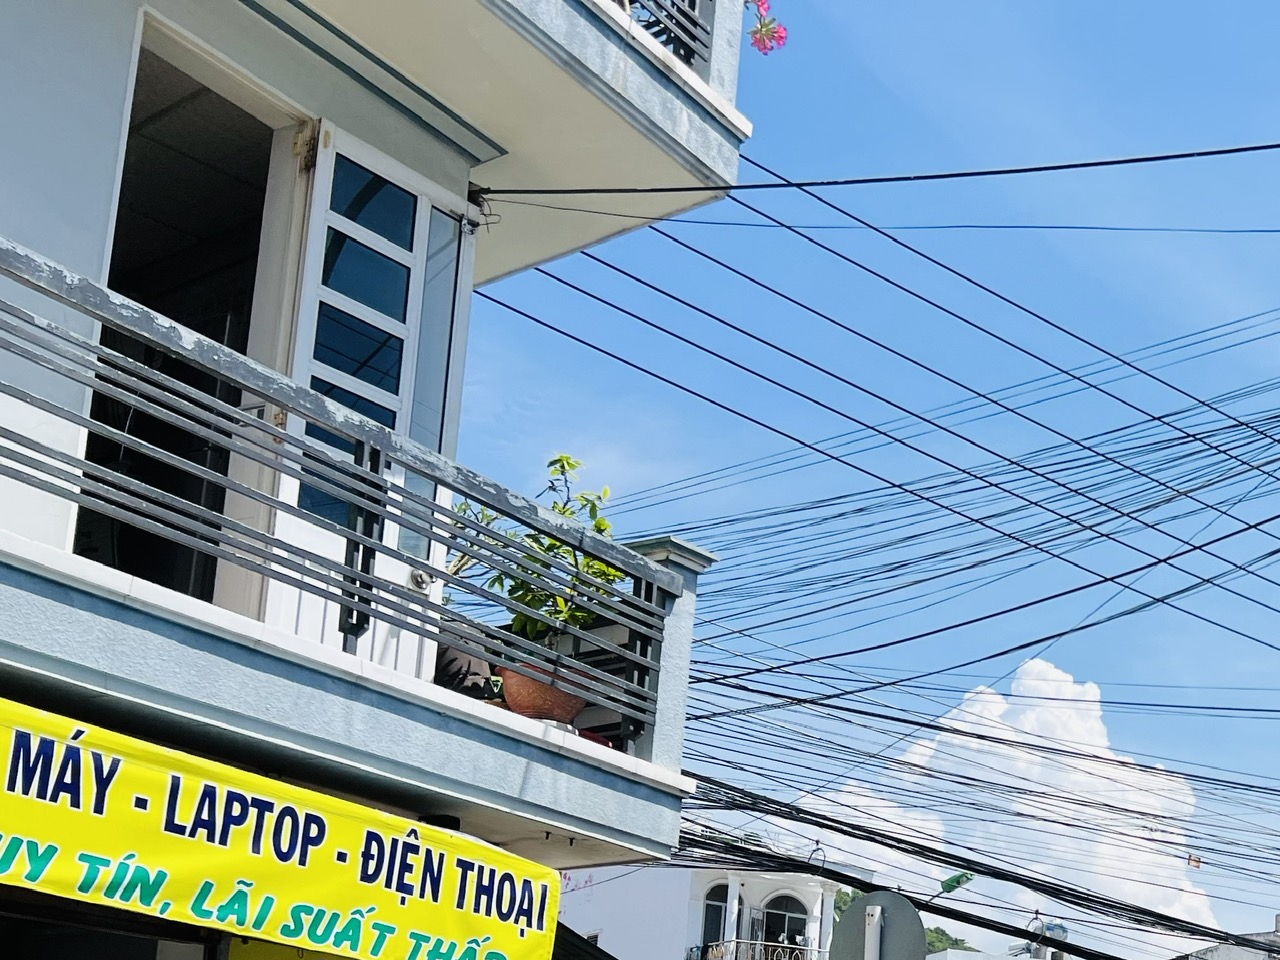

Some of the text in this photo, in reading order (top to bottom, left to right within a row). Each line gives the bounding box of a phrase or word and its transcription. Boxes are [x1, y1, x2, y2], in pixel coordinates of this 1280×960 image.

[6, 729, 122, 816] MÁY
[163, 774, 326, 867] LAPTOP
[360, 830, 445, 906] ĐIỆN
[455, 858, 549, 939] THOẠI
[76, 853, 168, 916] TÍN,
[191, 878, 276, 932] LÃI
[280, 904, 398, 960] SUẤT
